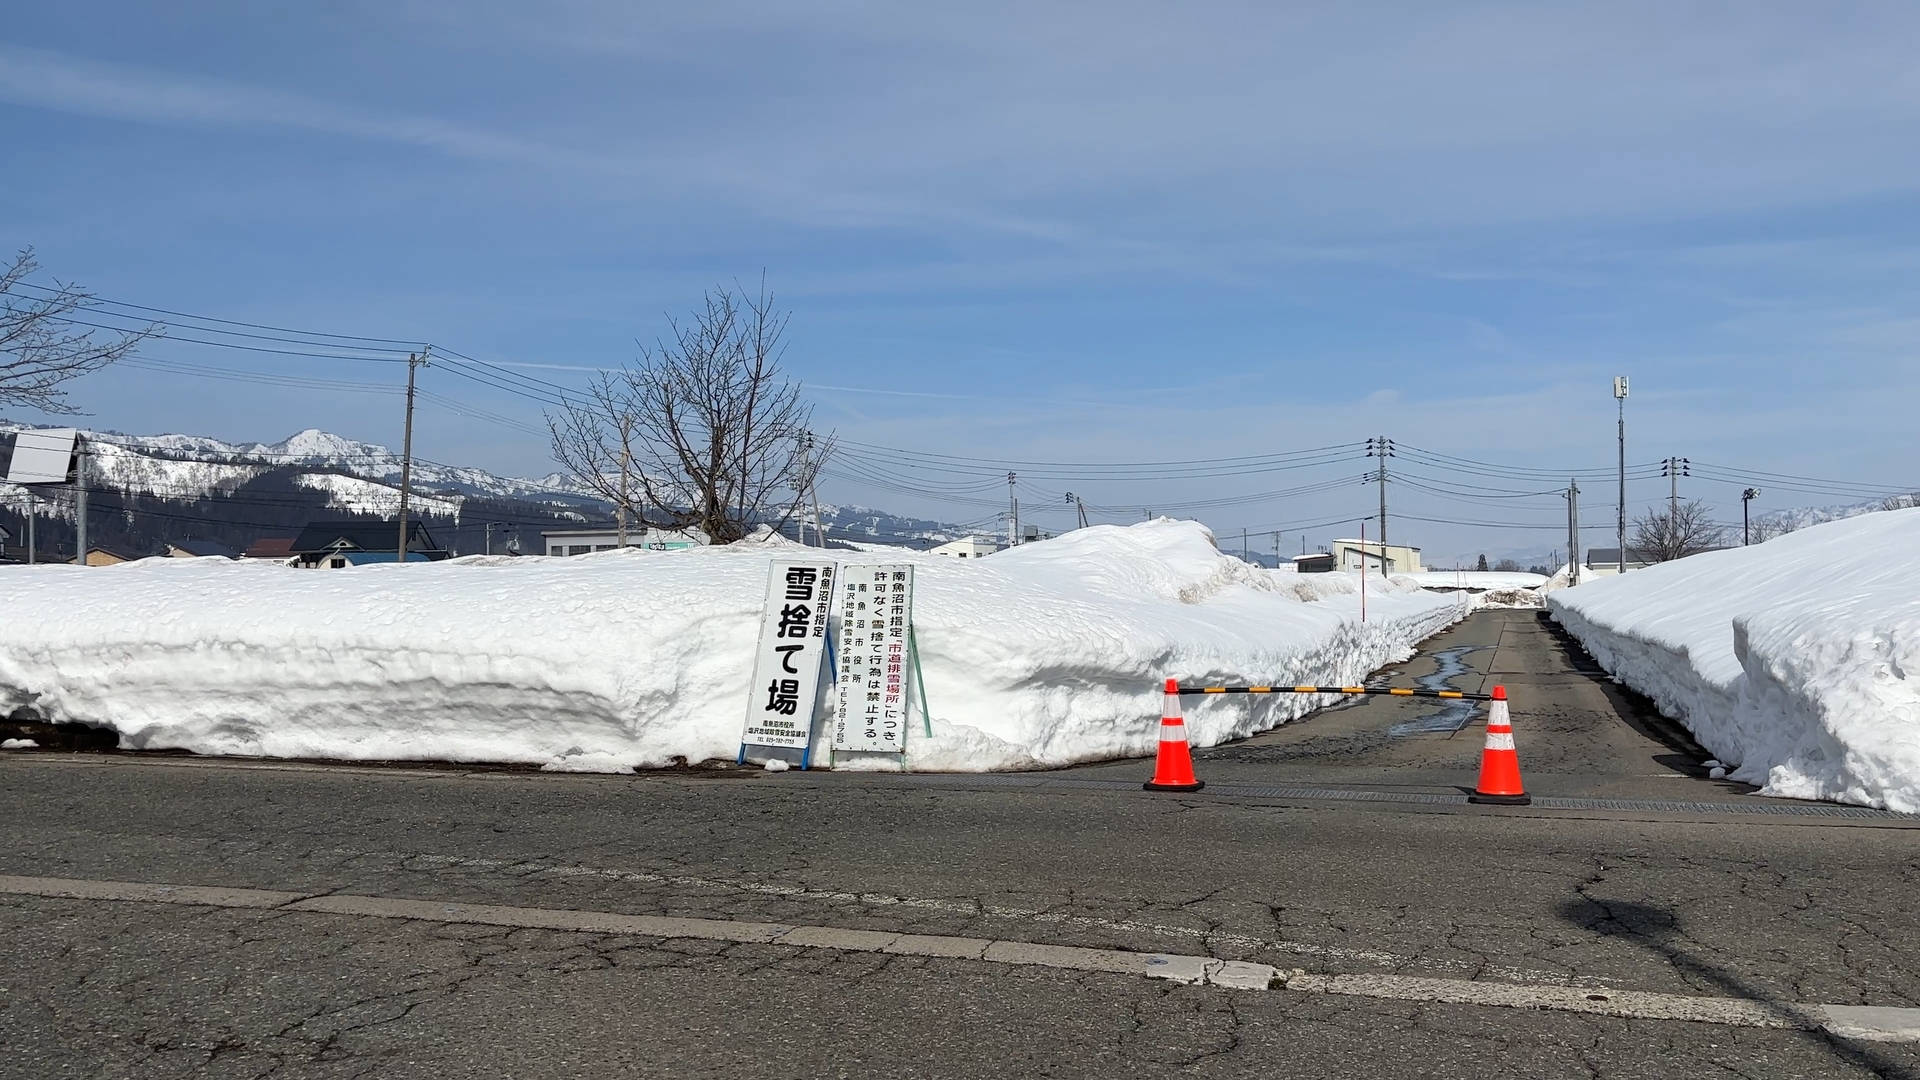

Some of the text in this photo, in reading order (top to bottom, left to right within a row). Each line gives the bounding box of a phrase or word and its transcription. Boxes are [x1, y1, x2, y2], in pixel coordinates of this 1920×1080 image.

[765, 567, 817, 715] 雪捨て場
[812, 566, 833, 638] 南魚沼市指定
[852, 583, 868, 684] 南魚沼市役所
[864, 571, 888, 746] 許可なく雪捨て行為は禁止する。
